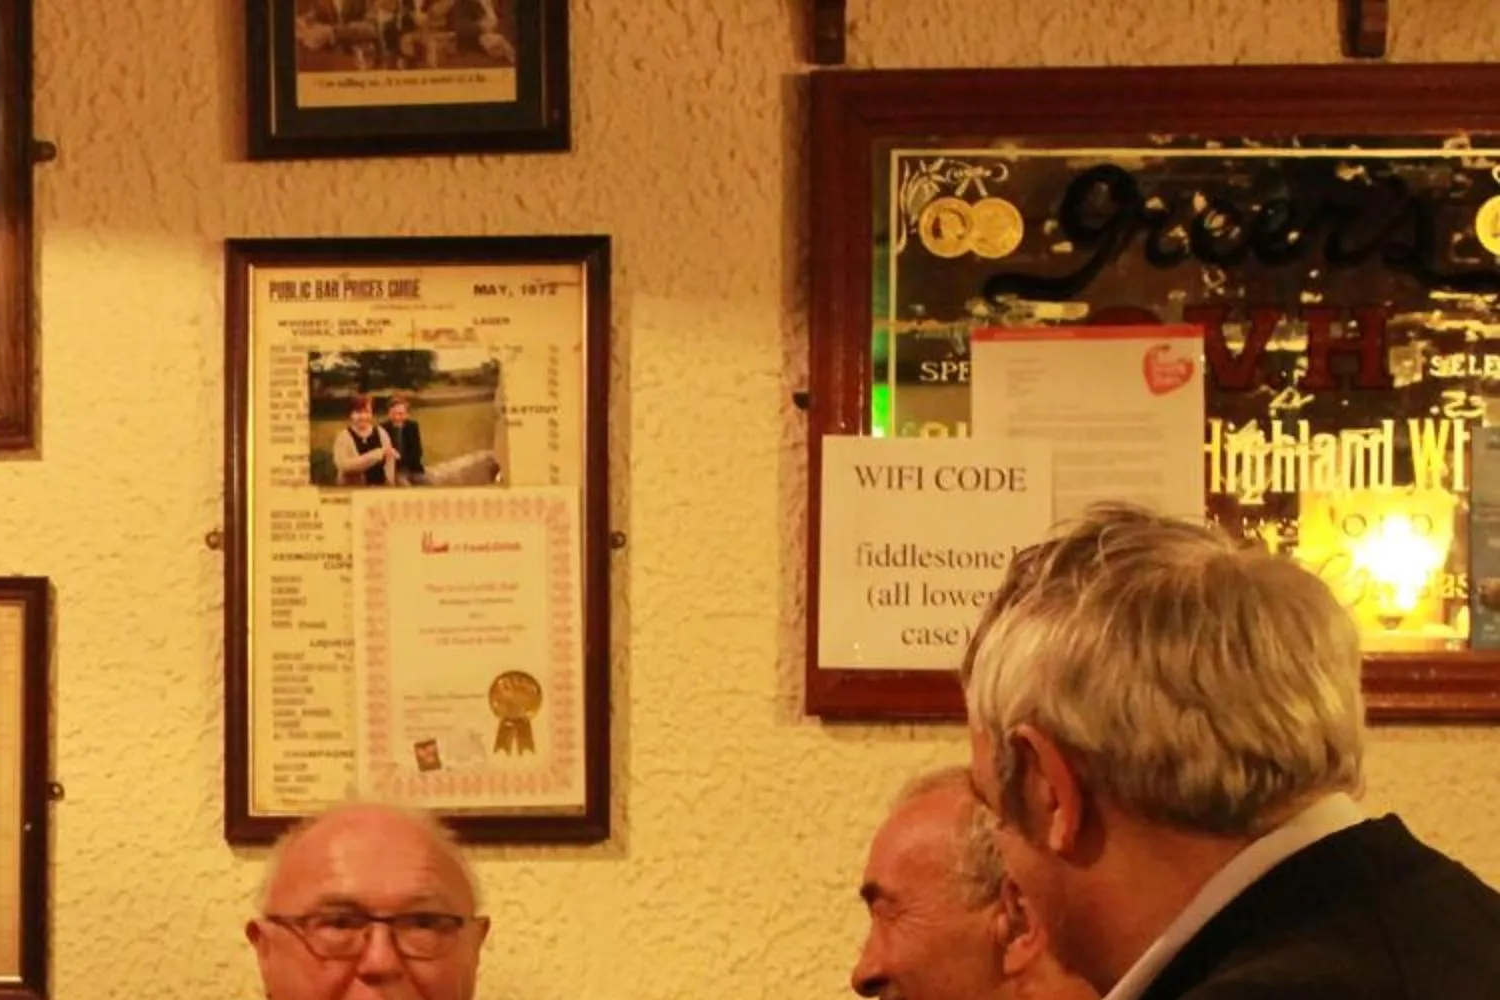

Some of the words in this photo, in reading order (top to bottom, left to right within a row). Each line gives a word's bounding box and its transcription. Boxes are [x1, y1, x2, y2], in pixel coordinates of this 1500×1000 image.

[853, 464, 924, 492] WIFI
[933, 465, 1028, 493] CODE
[866, 581, 911, 612] (all
